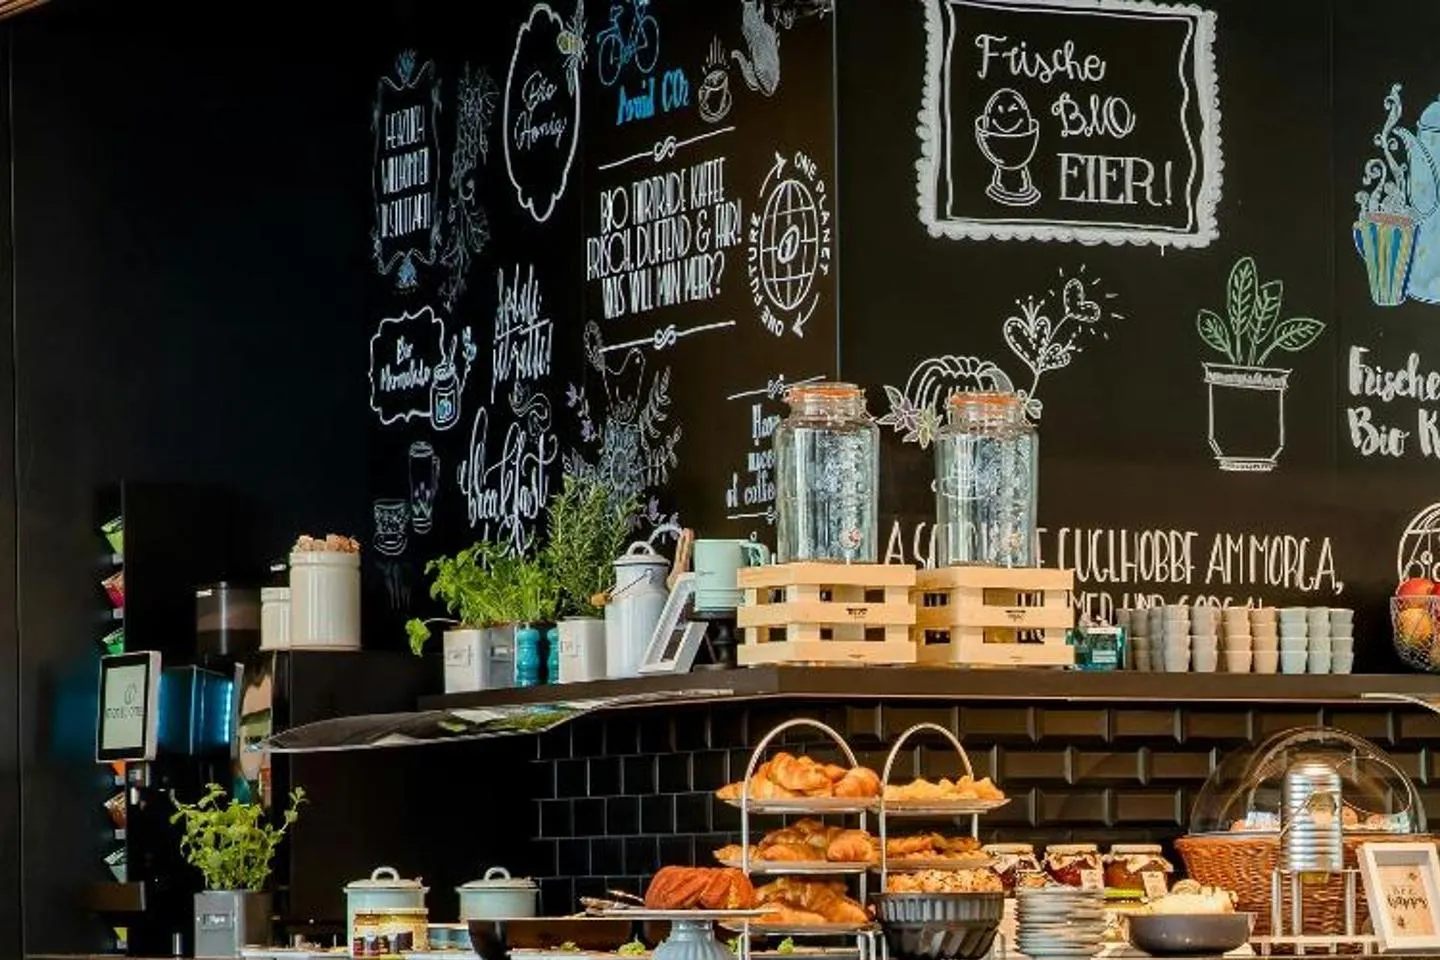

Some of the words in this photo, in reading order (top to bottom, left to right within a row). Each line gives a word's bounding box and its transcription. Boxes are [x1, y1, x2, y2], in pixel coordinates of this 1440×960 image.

[975, 34, 1106, 83] Frische
[1056, 153, 1172, 206] EIER!
[696, 209, 712, 253] &
[1347, 405, 1411, 456] Bio
[1205, 532, 1244, 585] AM
[1249, 534, 1344, 595] MORGA,
